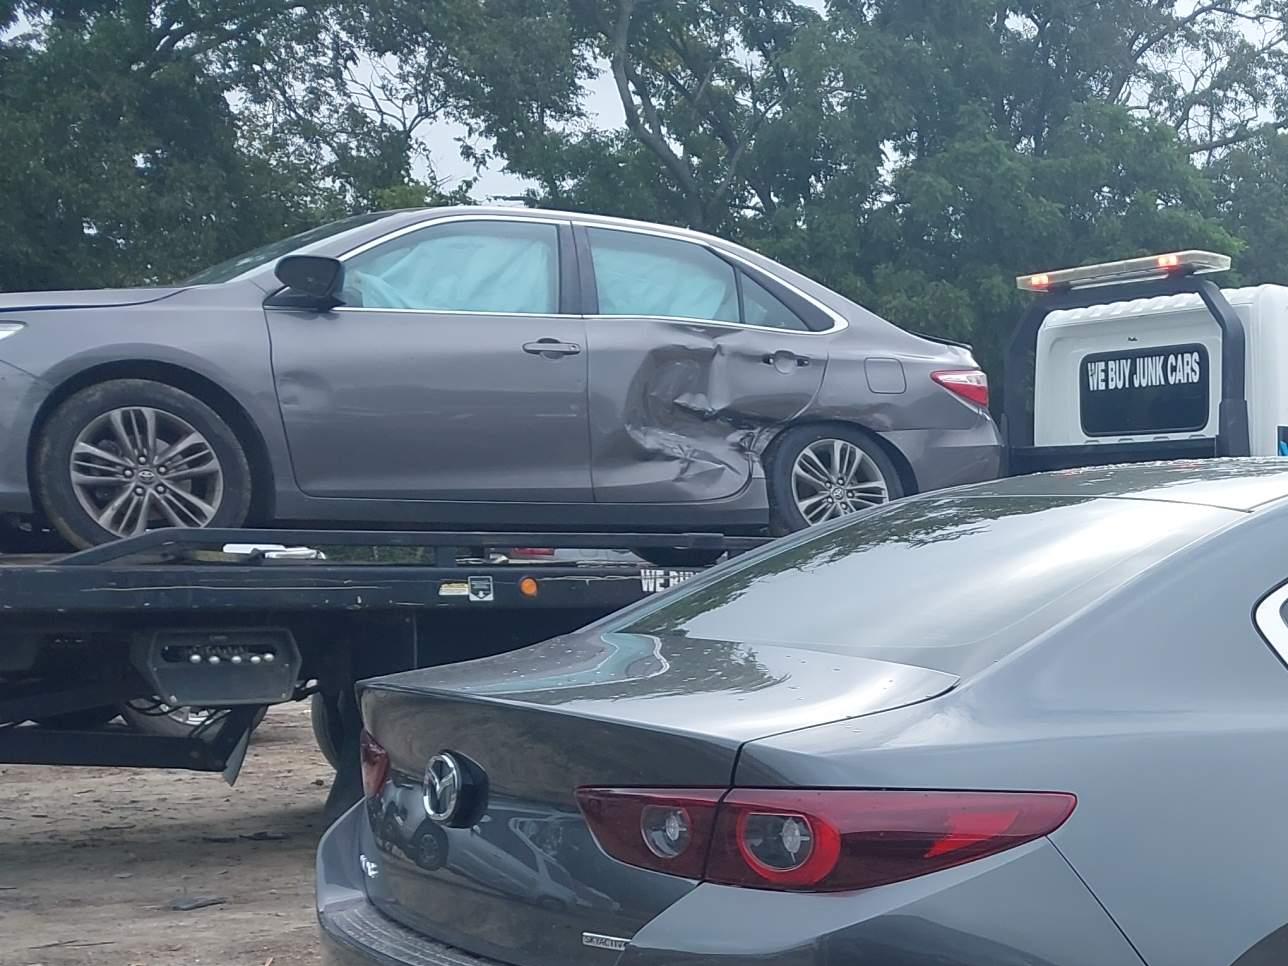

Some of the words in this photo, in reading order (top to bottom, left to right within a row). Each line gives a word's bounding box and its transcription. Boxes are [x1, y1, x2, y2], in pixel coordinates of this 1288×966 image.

[1088, 361, 1106, 391] WE
[1108, 359, 1132, 389] BUY
[1133, 355, 1166, 388] JUNK
[1167, 352, 1200, 385] CARS
